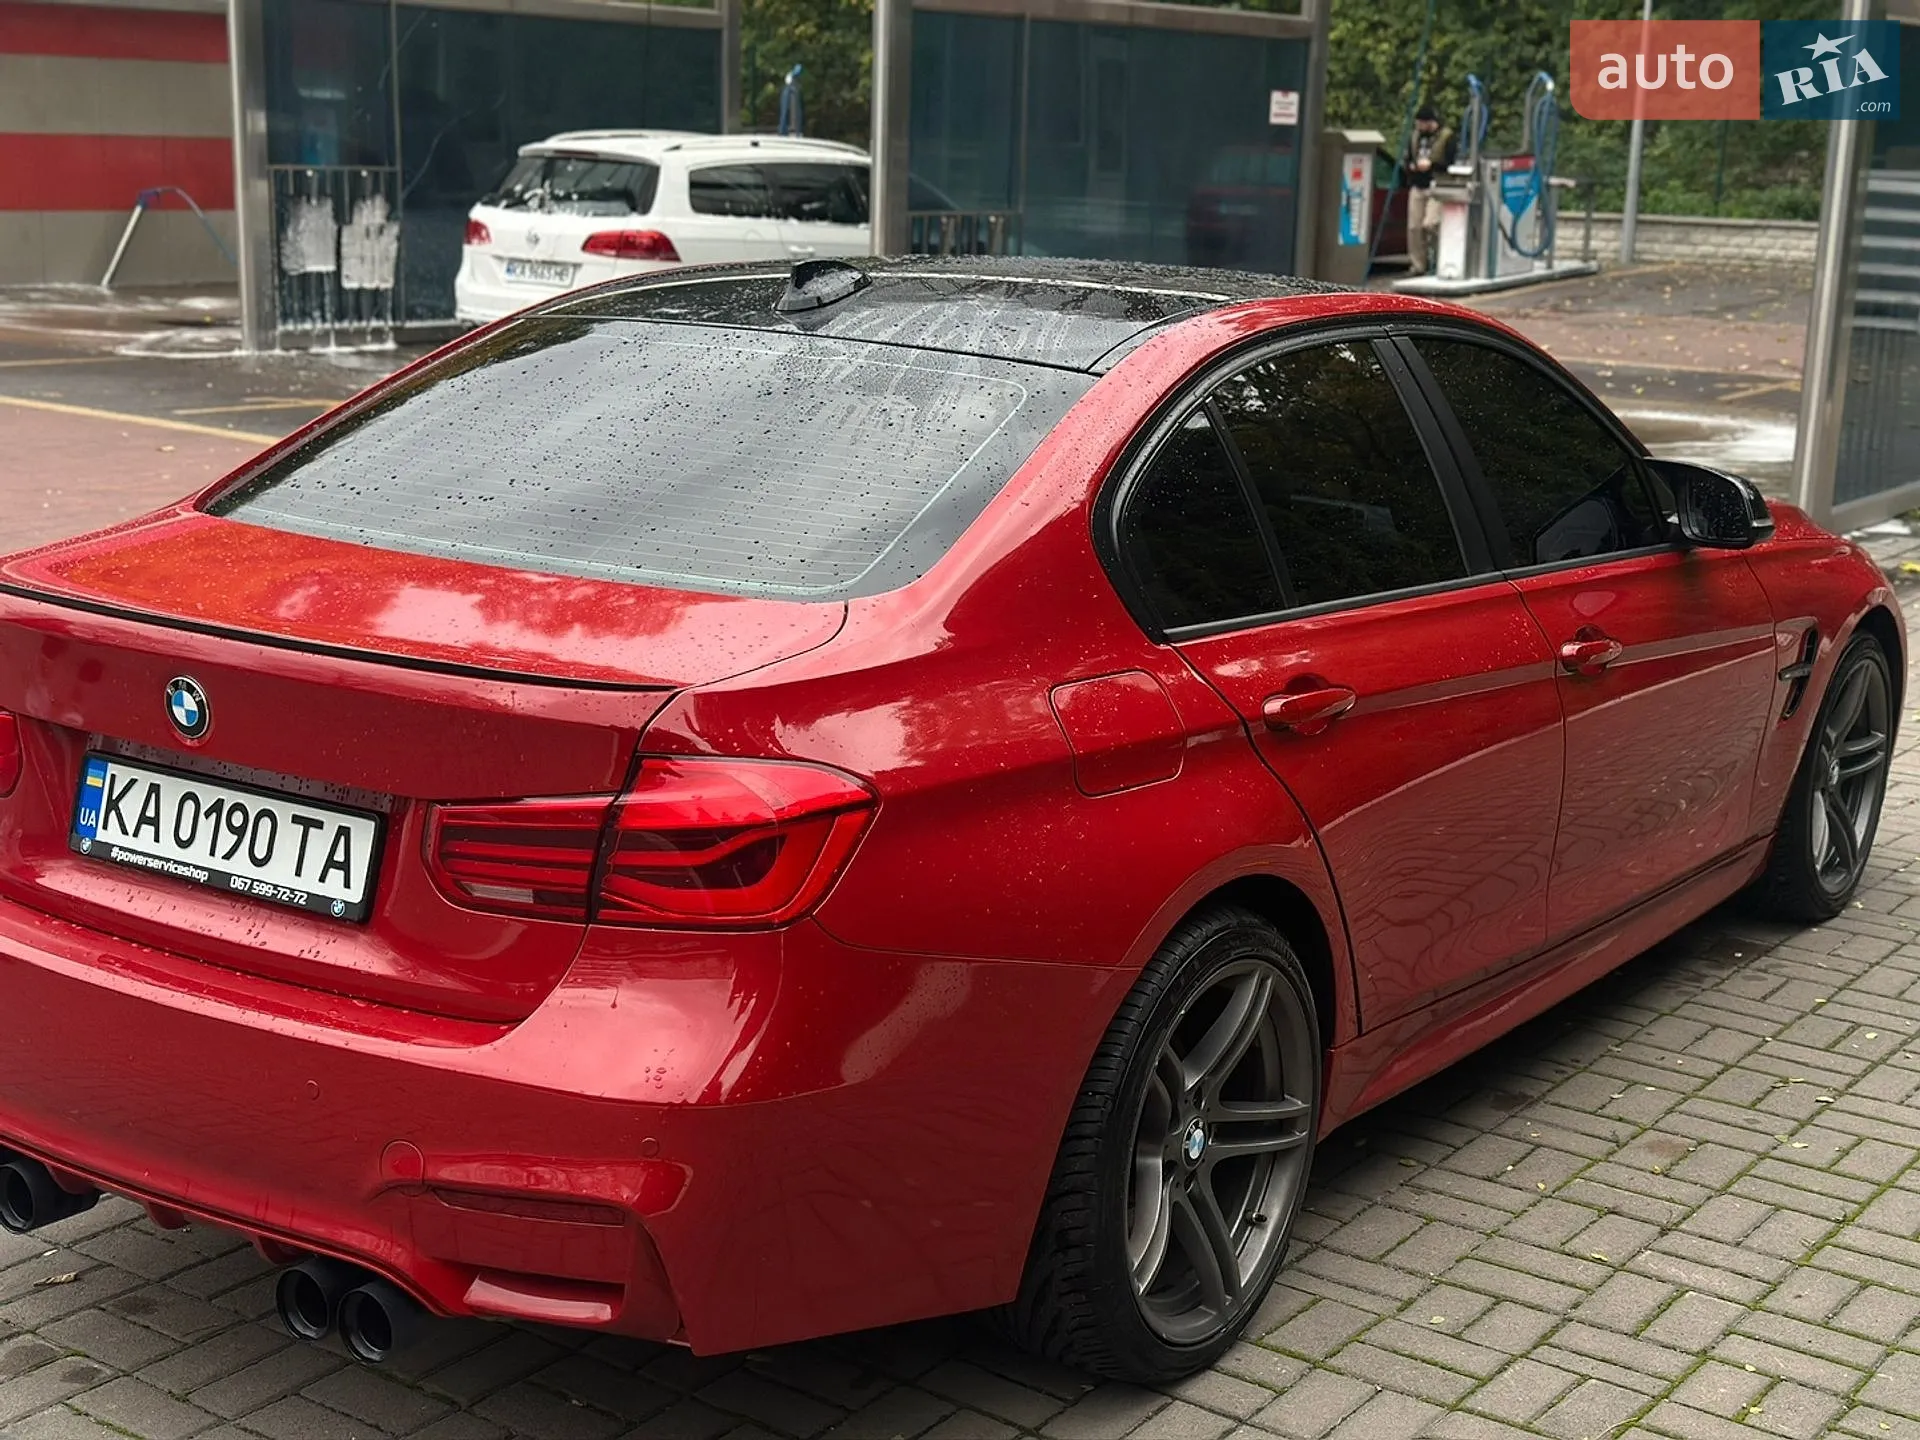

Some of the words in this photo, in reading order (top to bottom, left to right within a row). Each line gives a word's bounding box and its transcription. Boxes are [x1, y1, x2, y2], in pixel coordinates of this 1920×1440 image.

[79, 807, 96, 829] UA
[101, 773, 162, 844] KA
[173, 790, 279, 868] 0190
[290, 813, 352, 889] TA
[110, 846, 209, 883] #powerserviceshop
[230, 875, 252, 891] 067
[251, 881, 308, 905] 599-72-72
